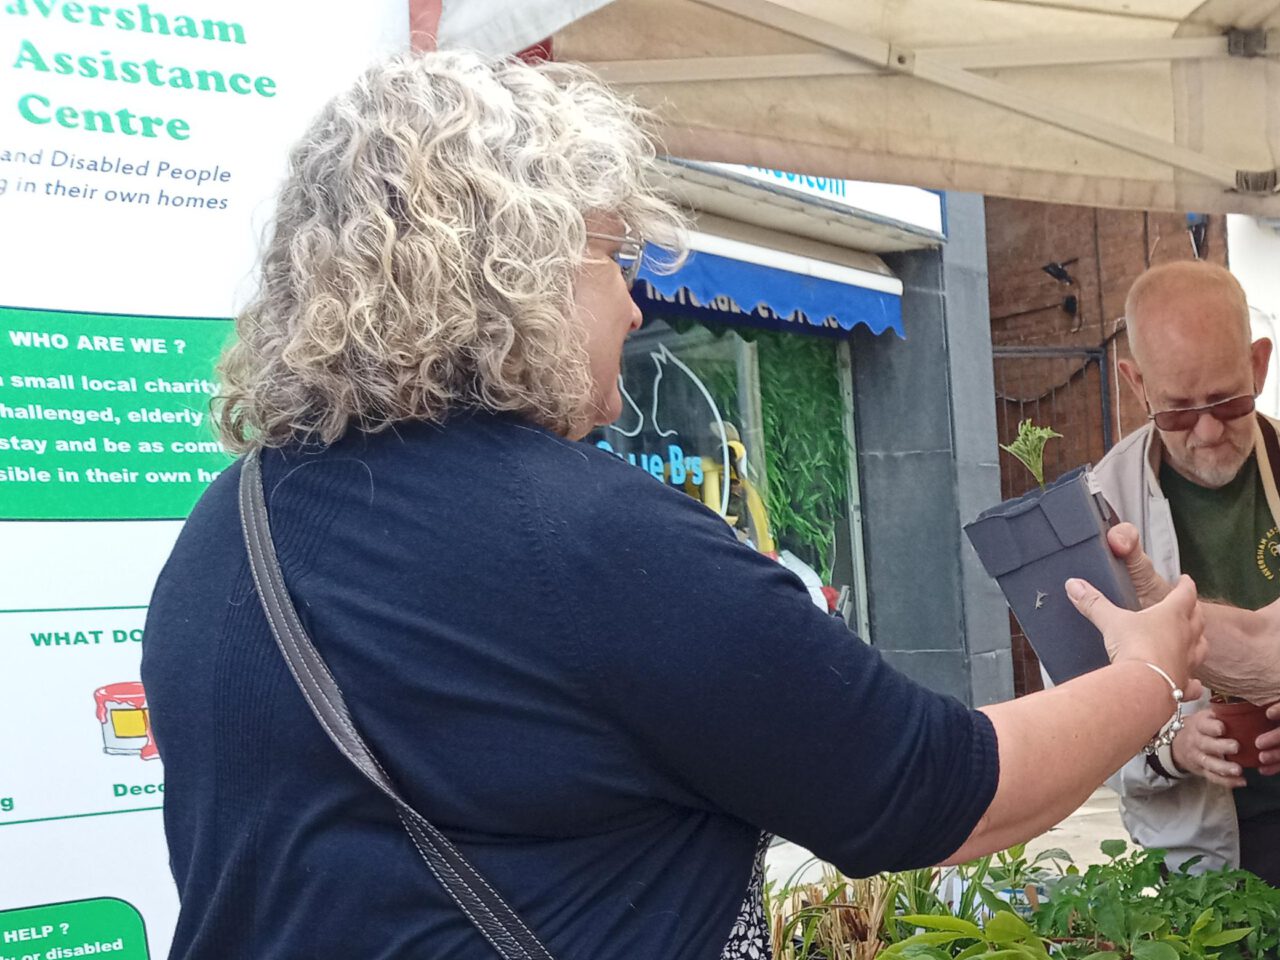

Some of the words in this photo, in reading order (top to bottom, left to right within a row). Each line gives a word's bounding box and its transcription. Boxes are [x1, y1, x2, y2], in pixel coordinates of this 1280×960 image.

[13, 39, 277, 98] Assistance
[17, 92, 190, 141] Centre
[0, 149, 43, 165] and
[51, 150, 150, 176] Disabled
[157, 161, 231, 186] People
[16, 177, 36, 193] in
[45, 180, 98, 199] their
[104, 190, 150, 204] own
[157, 189, 228, 210] homes
[9, 331, 69, 349] WHO
[77, 335, 125, 352] ARE
[130, 338, 167, 354] WE
[173, 339, 186, 354] ?
[10, 374, 75, 390] small
[82, 376, 137, 392] local
[127, 408, 203, 427] elderly
[0, 436, 47, 455] stay
[55, 437, 97, 452] and
[103, 438, 131, 452] be
[138, 441, 164, 453] as
[58, 468, 79, 482] in
[87, 469, 139, 482] their
[145, 471, 192, 482] own
[31, 630, 103, 646] WHAT
[4, 925, 54, 943] HELP
[60, 923, 70, 934] ?
[46, 938, 123, 960] disabled
